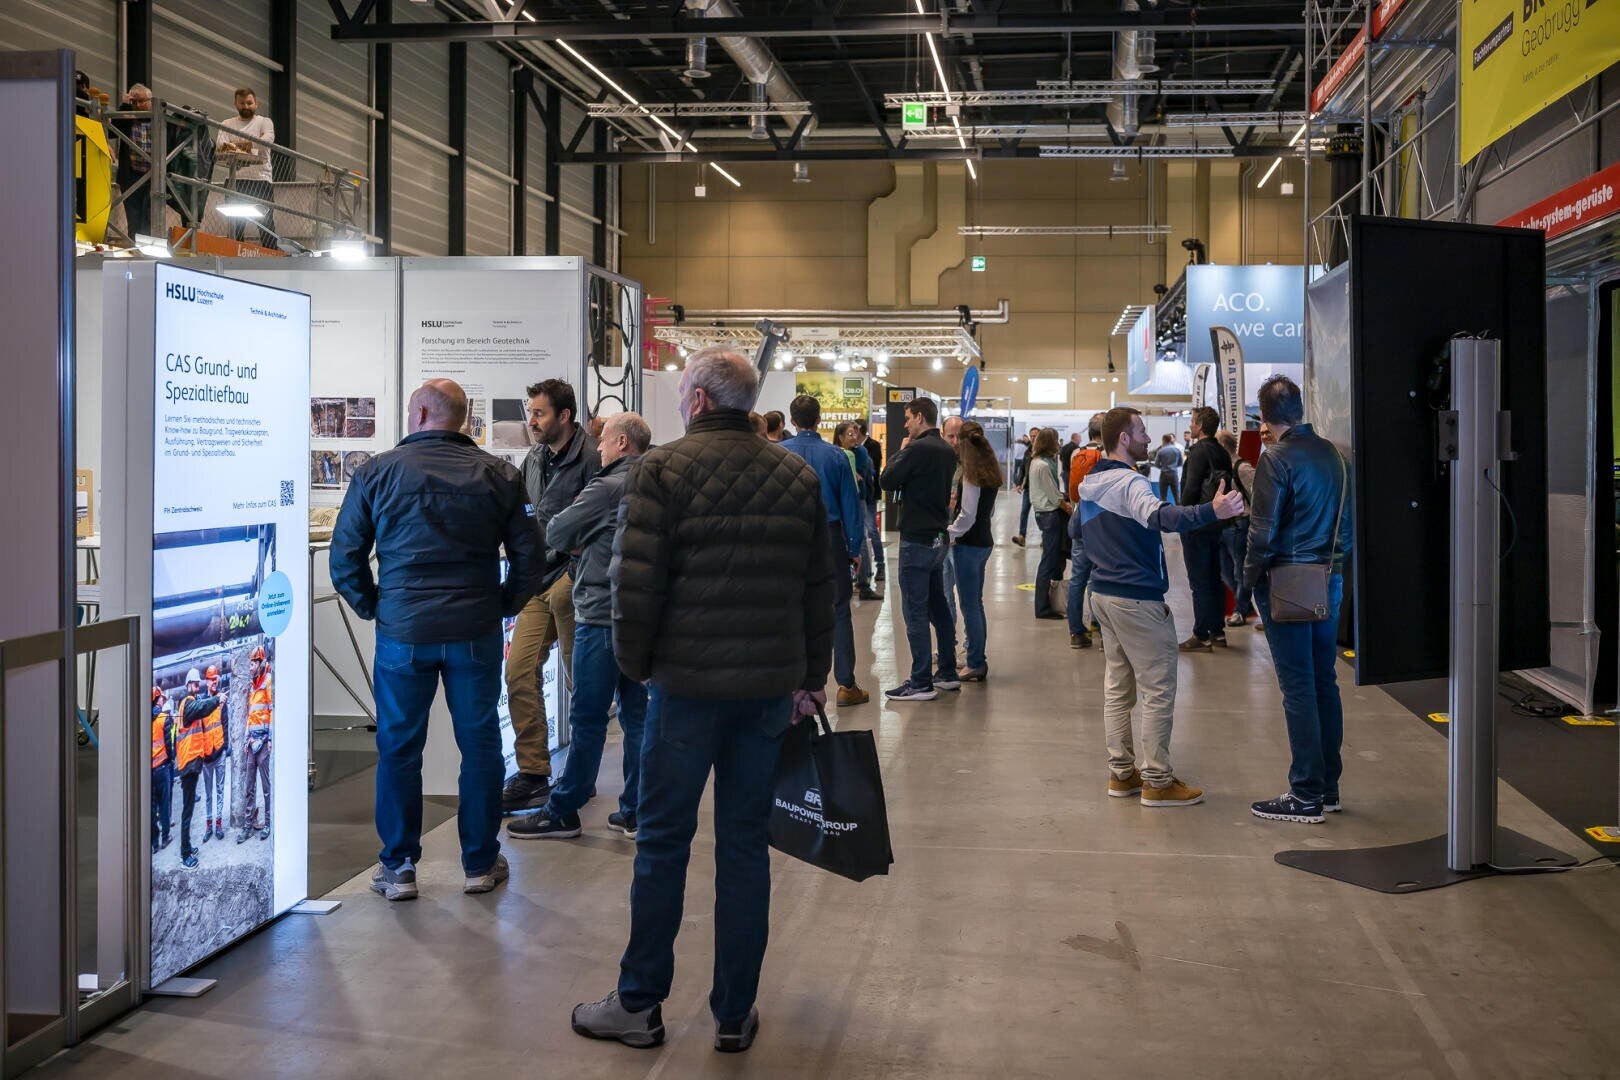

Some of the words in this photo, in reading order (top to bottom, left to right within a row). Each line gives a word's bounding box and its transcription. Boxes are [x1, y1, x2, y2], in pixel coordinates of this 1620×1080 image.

[1521, 0, 1580, 57] Geobrugg
[1521, 184, 1614, 232] hr-system-gerüste
[166, 282, 196, 302] HSLU
[197, 288, 224, 300] Hochschule
[197, 297, 213, 306] Luzern
[1213, 292, 1271, 312] ACO.
[421, 320, 442, 328] HSLU
[1233, 322, 1264, 337] we
[421, 337, 455, 346] Forschung
[466, 337, 491, 345] Bereich
[492, 337, 530, 345] Geotechnik
[166, 353, 191, 373] CAS
[195, 356, 234, 377] Grund-
[237, 363, 257, 380] und
[165, 380, 249, 405] Spezialtiefbau
[820, 412, 861, 420] MPETENZ
[267, 499, 277, 508] CAS
